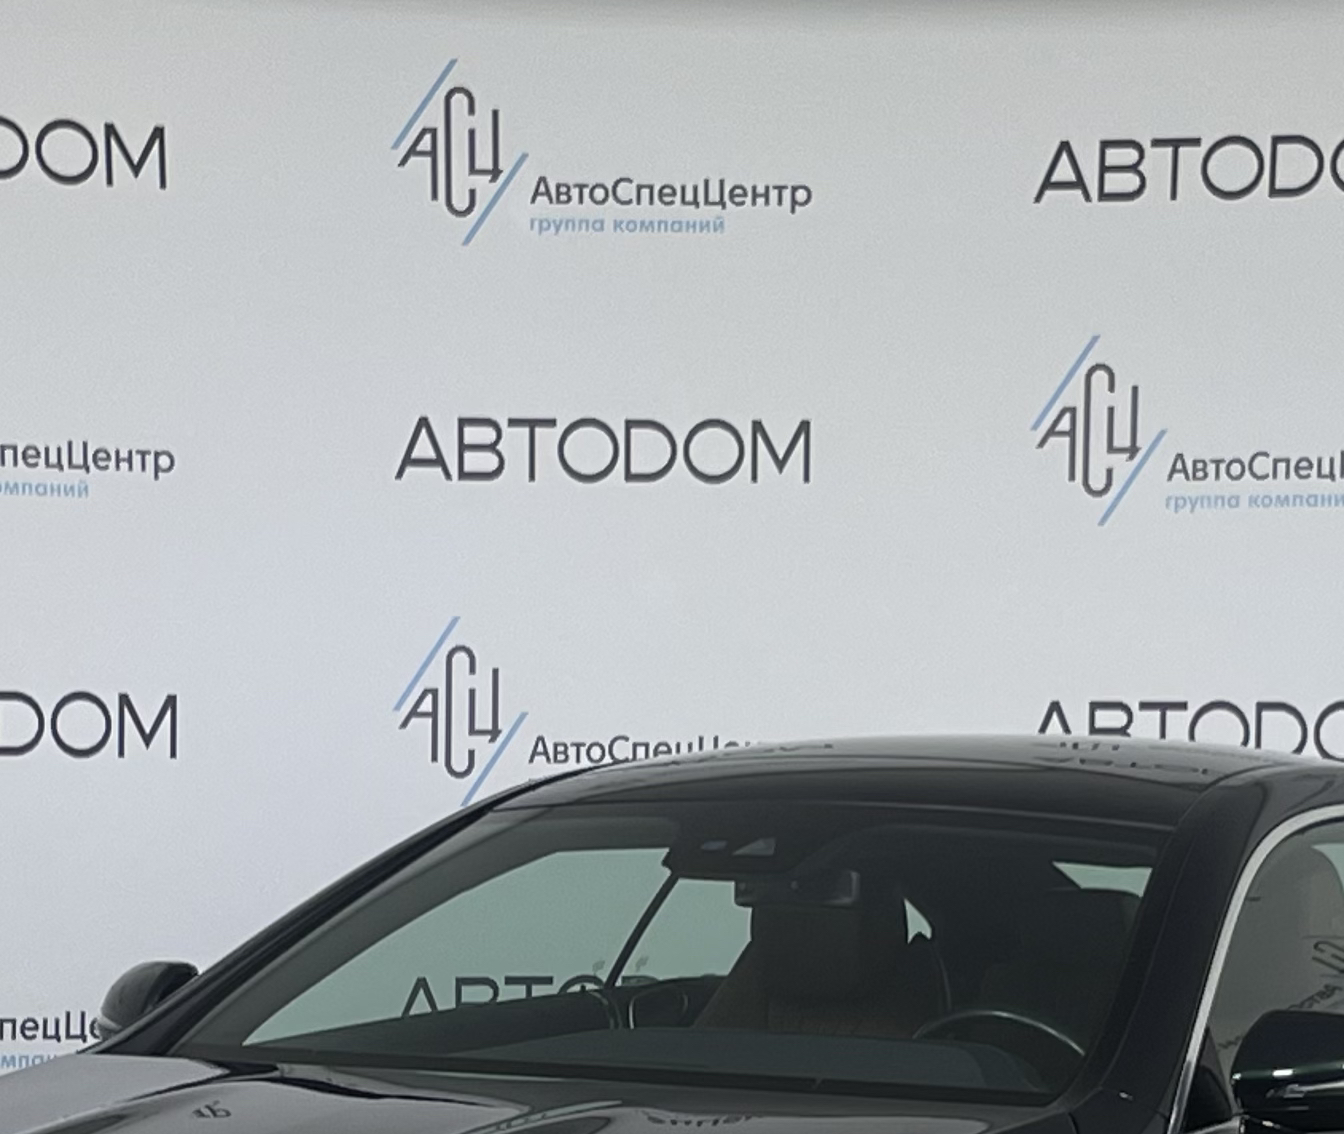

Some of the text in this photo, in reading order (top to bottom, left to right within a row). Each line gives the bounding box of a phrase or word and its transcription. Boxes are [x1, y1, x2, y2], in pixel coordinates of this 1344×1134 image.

[529, 176, 814, 214] АвтоСпецЦентр
[529, 216, 726, 235] группа компаний
[395, 415, 812, 485] ABTODOM
[1164, 493, 1241, 514] группа
